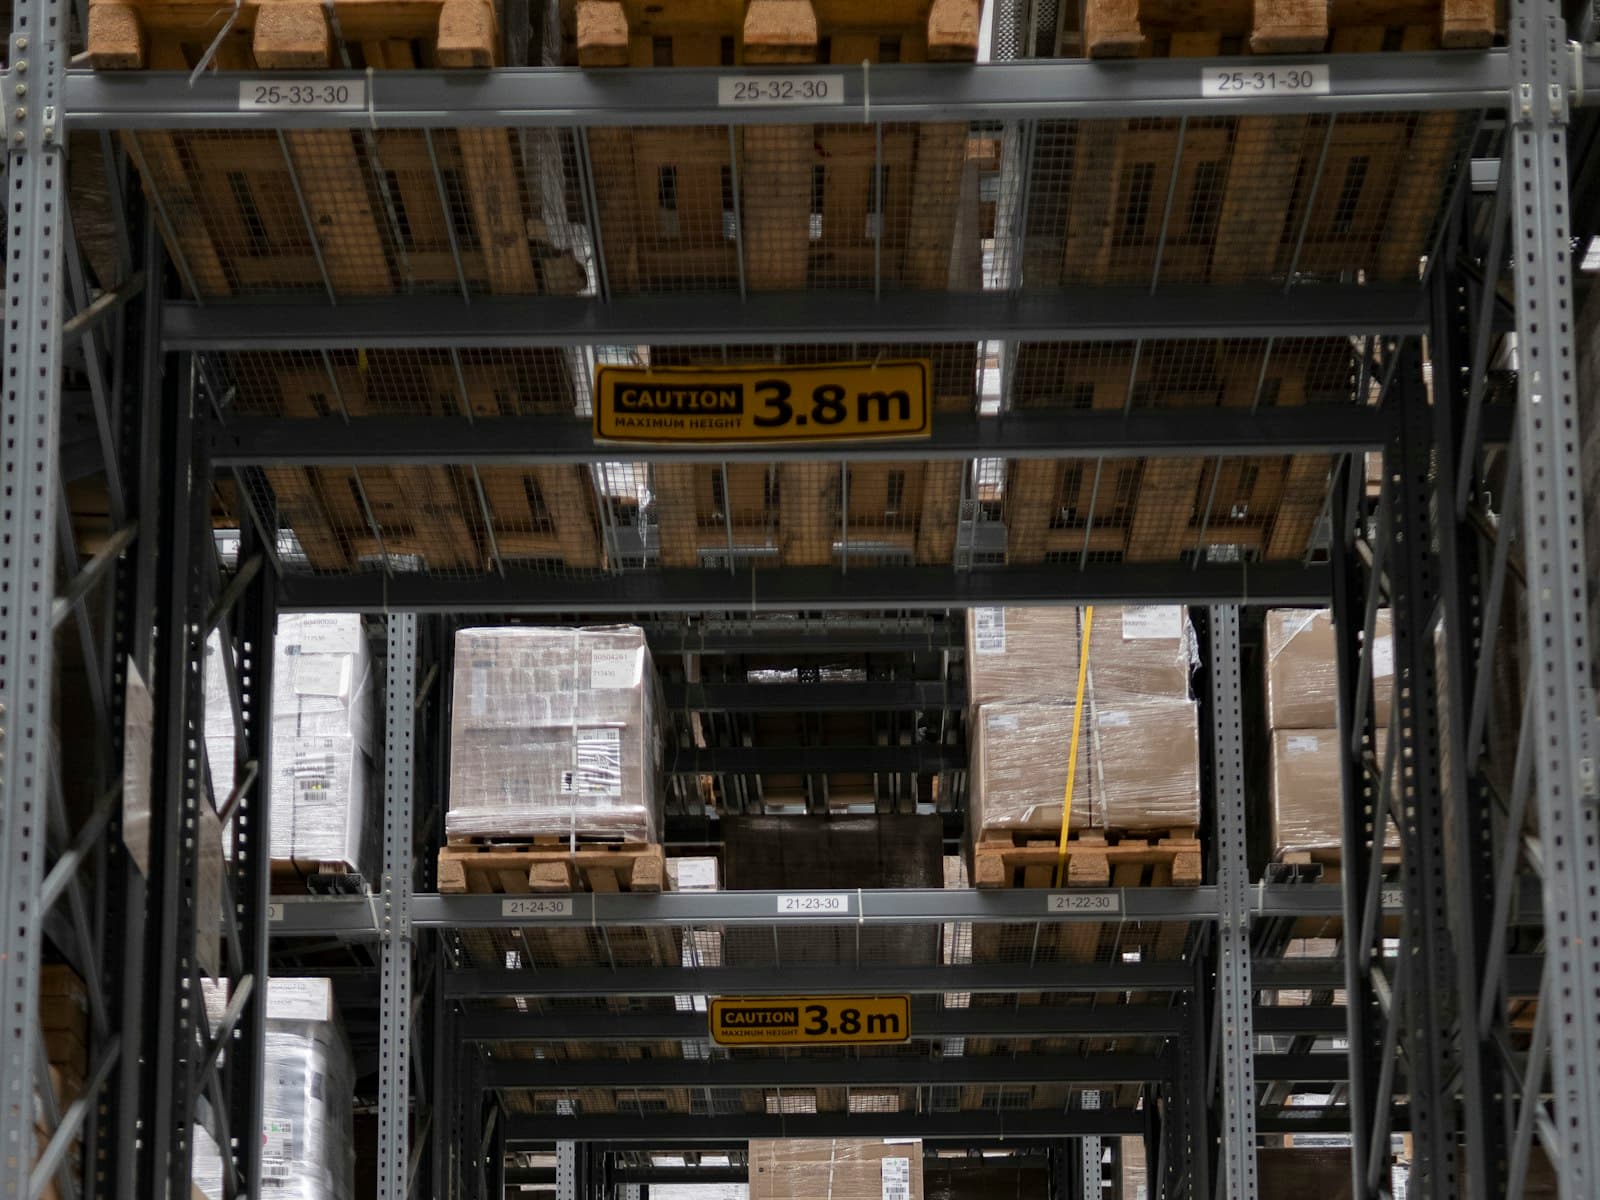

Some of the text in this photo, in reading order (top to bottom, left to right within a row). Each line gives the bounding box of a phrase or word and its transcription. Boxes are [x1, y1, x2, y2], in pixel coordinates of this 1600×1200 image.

[1217, 70, 1314, 91] 25-31-30
[254, 85, 349, 104] 25-33-30
[733, 80, 829, 100] 25-32-30
[621, 388, 736, 410] CAUTION
[615, 416, 743, 431] MAXIMUM HEIGHT
[511, 901, 564, 913] 21-24-30
[786, 897, 839, 909] 21-23-30
[1056, 896, 1110, 908] 21-22-30
[725, 1011, 795, 1024] CAUTION
[721, 1028, 798, 1037] MAXIMUM HEIGHT
